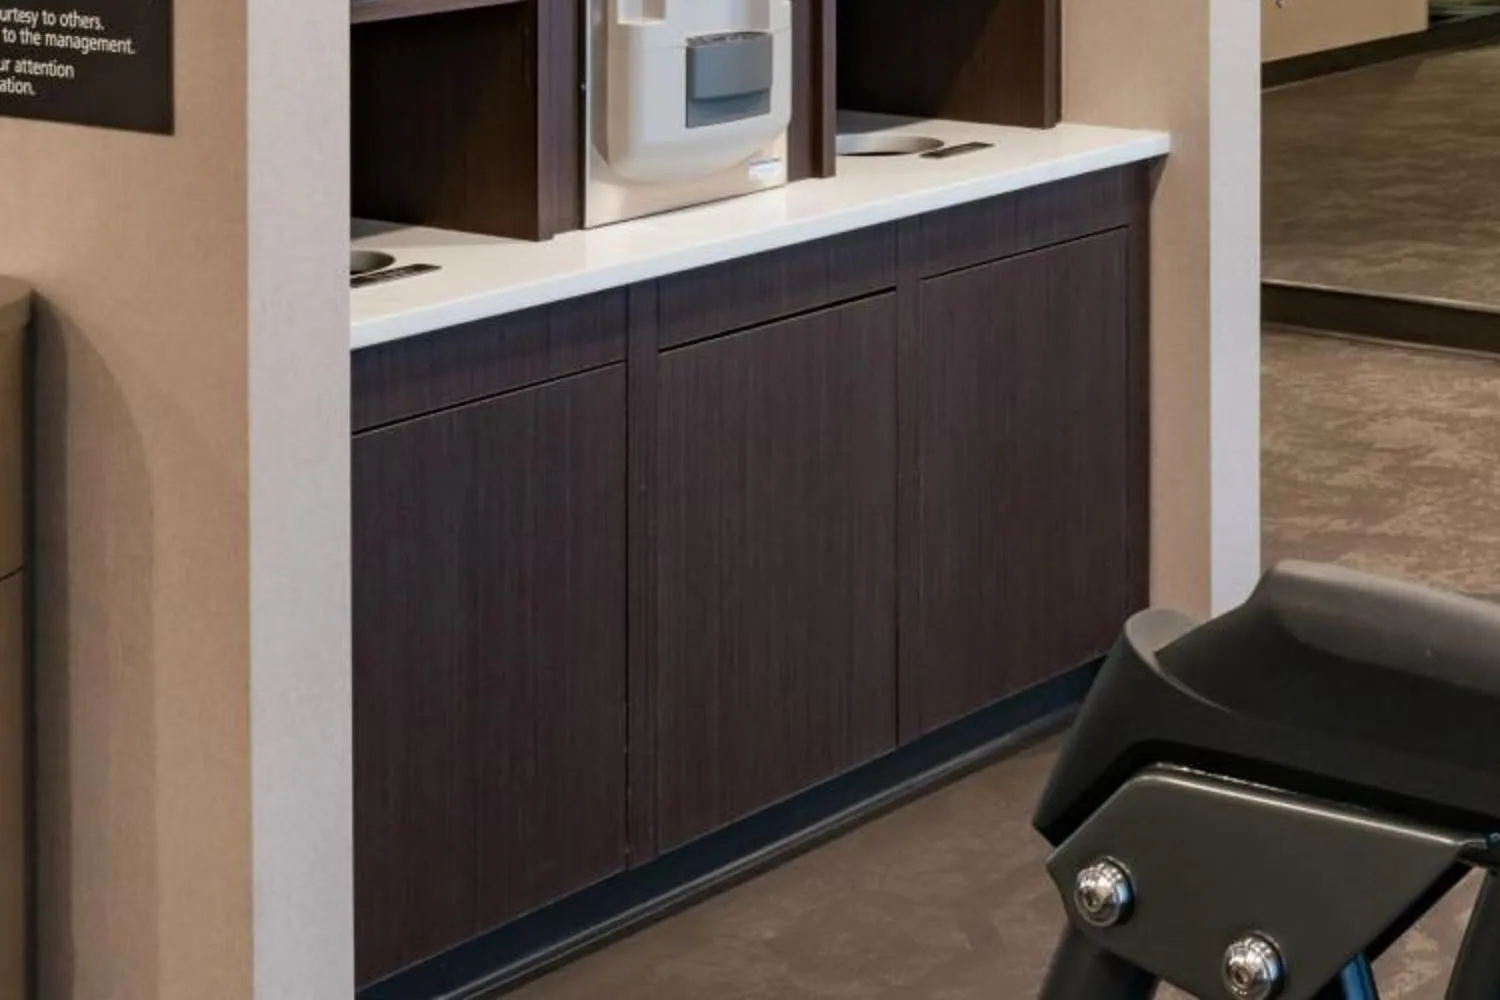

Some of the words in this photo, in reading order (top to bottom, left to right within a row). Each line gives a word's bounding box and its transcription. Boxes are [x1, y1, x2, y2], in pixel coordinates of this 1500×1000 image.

[42, 9, 56, 26] to
[2, 27, 17, 44] to
[19, 26, 41, 46] the
[45, 31, 137, 56] management.
[14, 56, 75, 79] attention
